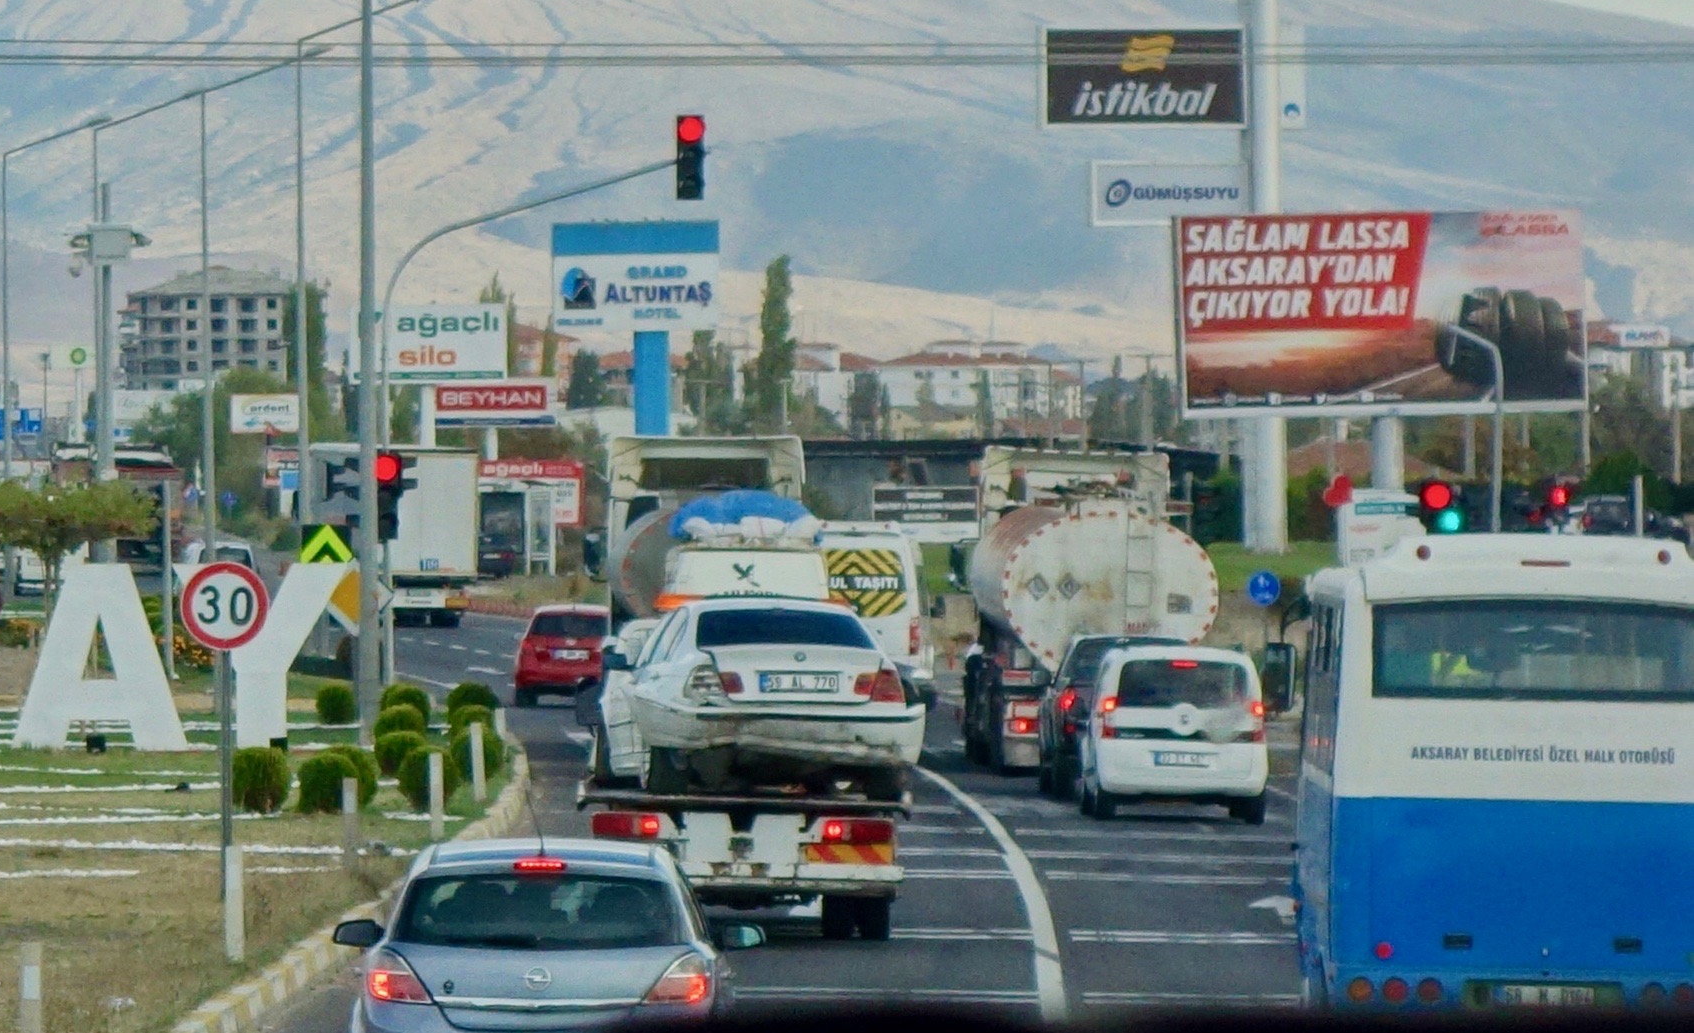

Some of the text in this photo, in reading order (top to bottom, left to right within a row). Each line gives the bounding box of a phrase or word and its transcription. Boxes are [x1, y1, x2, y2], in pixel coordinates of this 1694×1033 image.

[1072, 80, 1218, 116] istikbal
[1133, 184, 1239, 202] GÜMÜŞSUYU
[1186, 220, 1410, 253] SAĞLAM LASSA
[627, 265, 687, 279] GRAND
[1186, 254, 1396, 286] AKSARAY'DAN
[605, 280, 712, 307] ALTUNTAŞ
[633, 308, 681, 319] HOTEL
[1188, 286, 1410, 328] ÇIKIYOR YOLA!
[397, 311, 499, 338] ağaçlı
[399, 345, 456, 366] silo
[442, 390, 542, 407] BEYHAN
[830, 576, 898, 591] UL TAŞITI
[197, 585, 251, 626] 30
[814, 676, 836, 688] 770
[1411, 745, 1675, 765] AKSARAY BELEDİYESİ ÖZEL HALK OTOBÜSÜ
